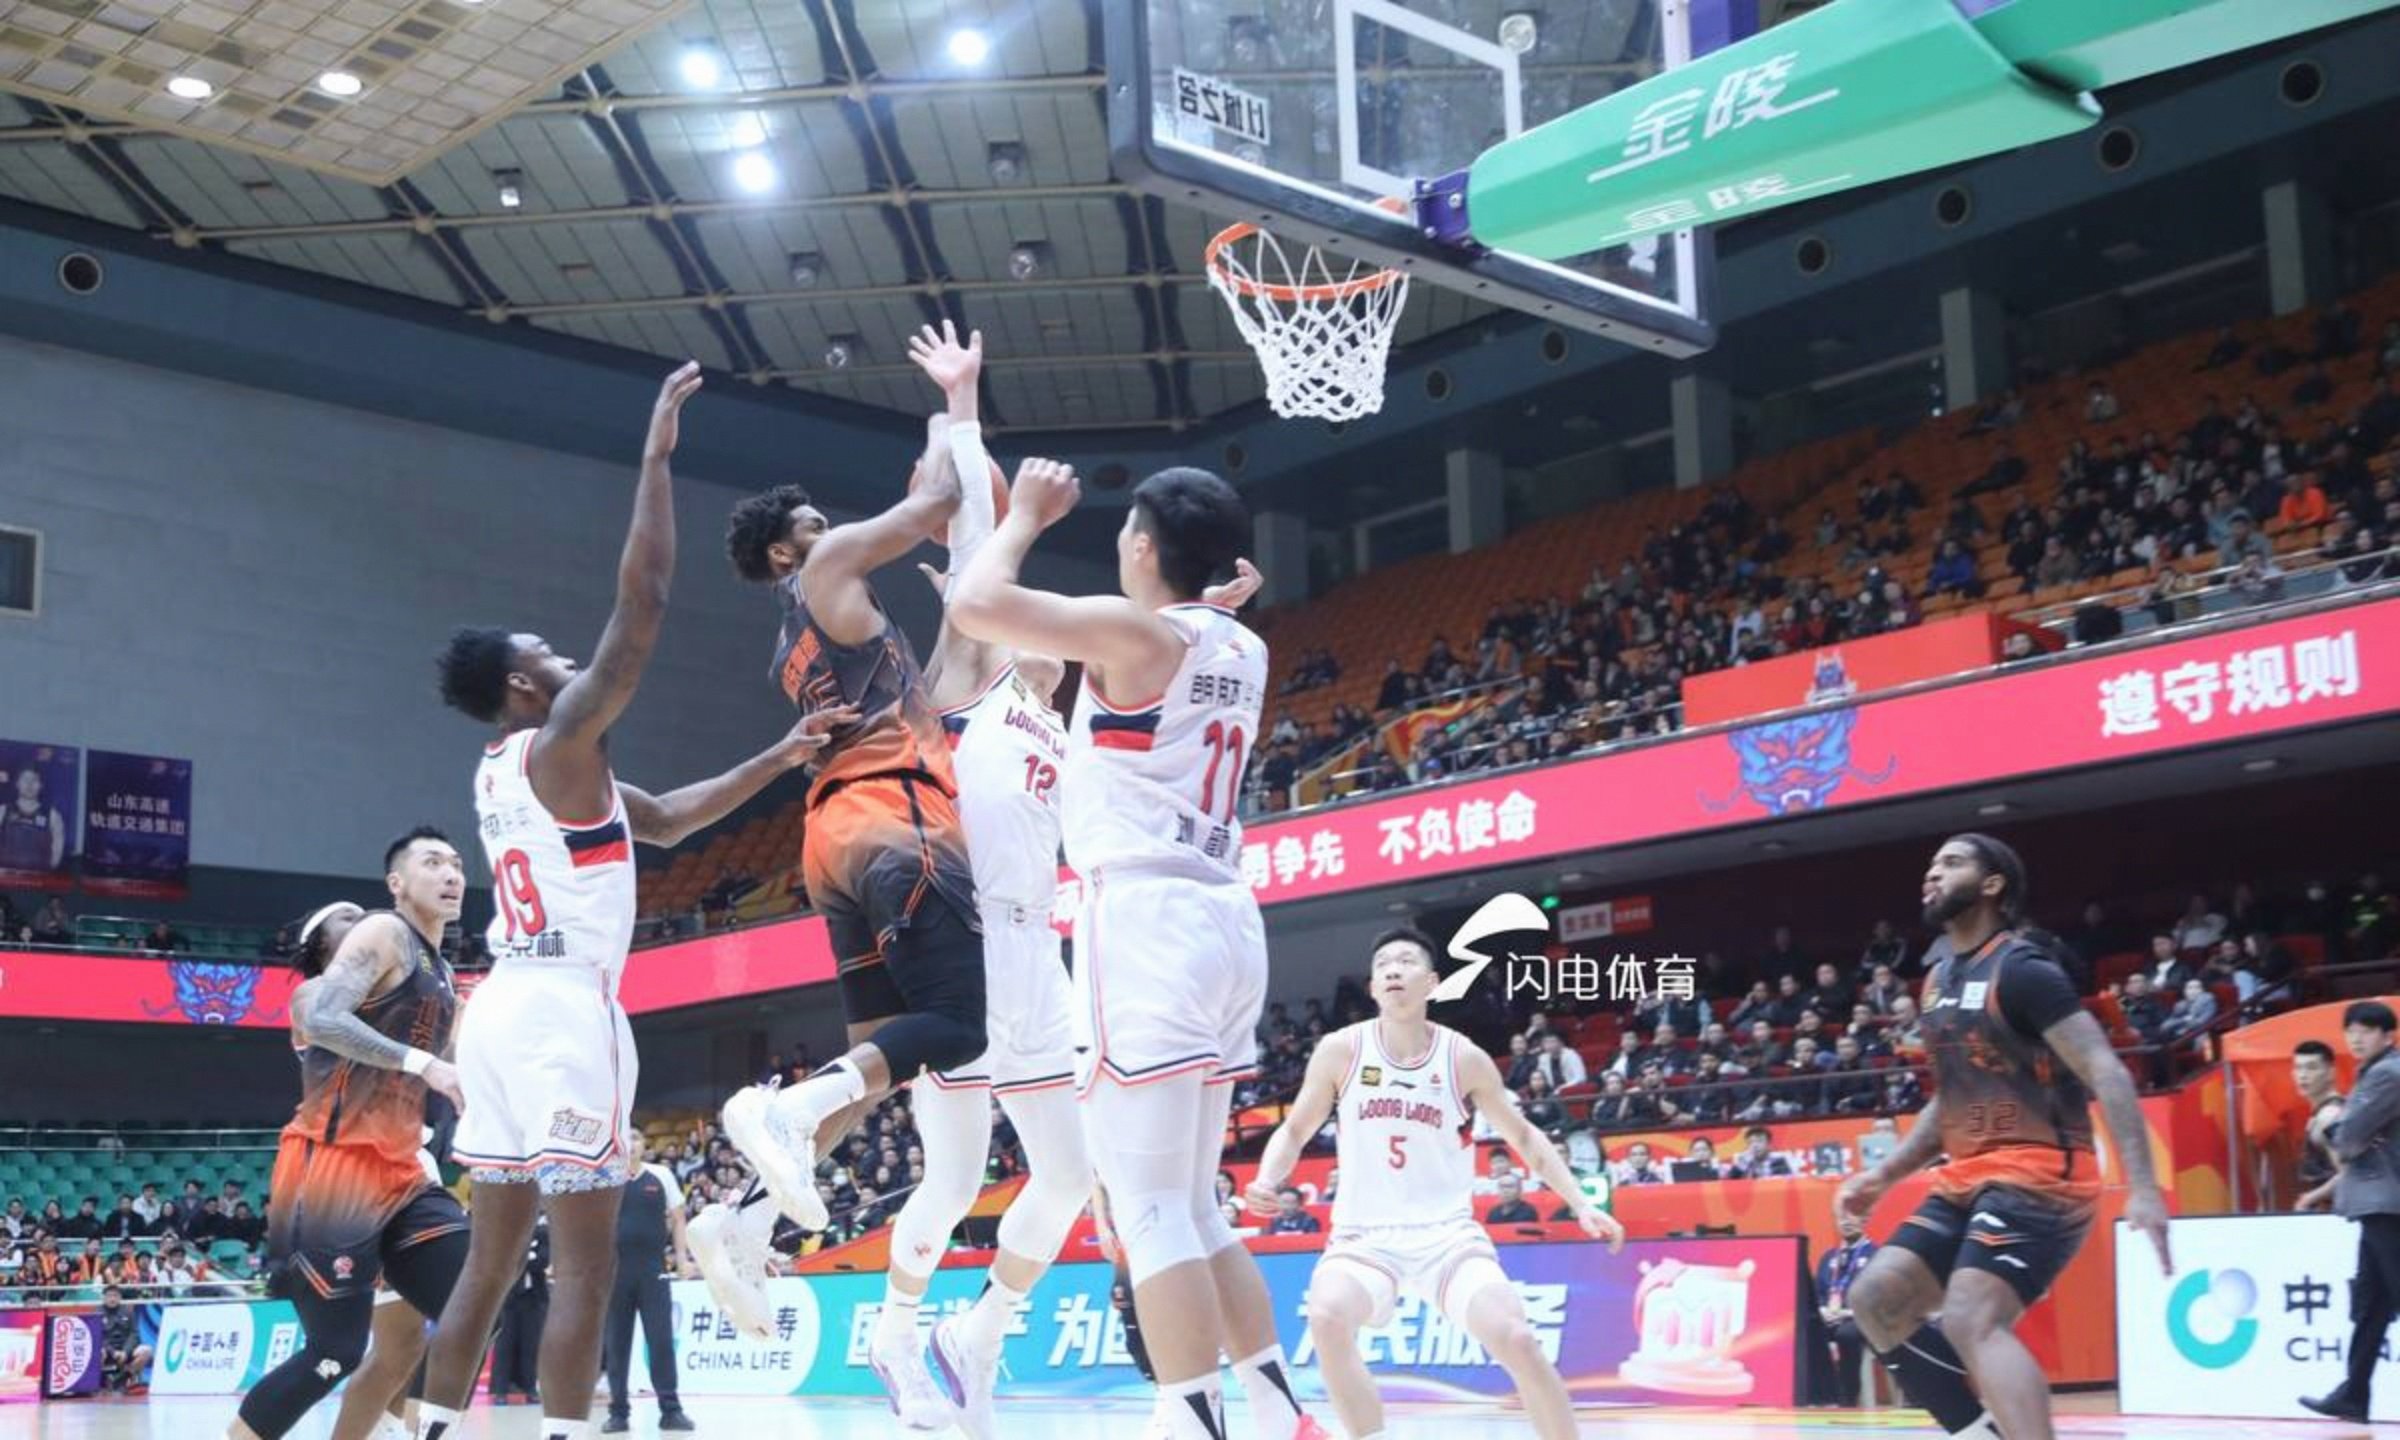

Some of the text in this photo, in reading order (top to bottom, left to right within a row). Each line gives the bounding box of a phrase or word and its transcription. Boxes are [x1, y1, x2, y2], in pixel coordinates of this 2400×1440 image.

[1586, 51, 1840, 183] 金陵
[2098, 629, 2361, 737] 遵守规则
[1024, 753, 1057, 806] 12
[1200, 720, 1243, 827] 11
[89, 811, 186, 836] 轨道交通集团
[106, 793, 171, 816] 山东高速
[1378, 789, 1537, 865] 不负使命
[495, 848, 547, 942] 19
[1388, 1135, 1408, 1170] 5
[690, 1306, 799, 1342] 中国寿
[686, 1350, 792, 1371] CHINA LIFE
